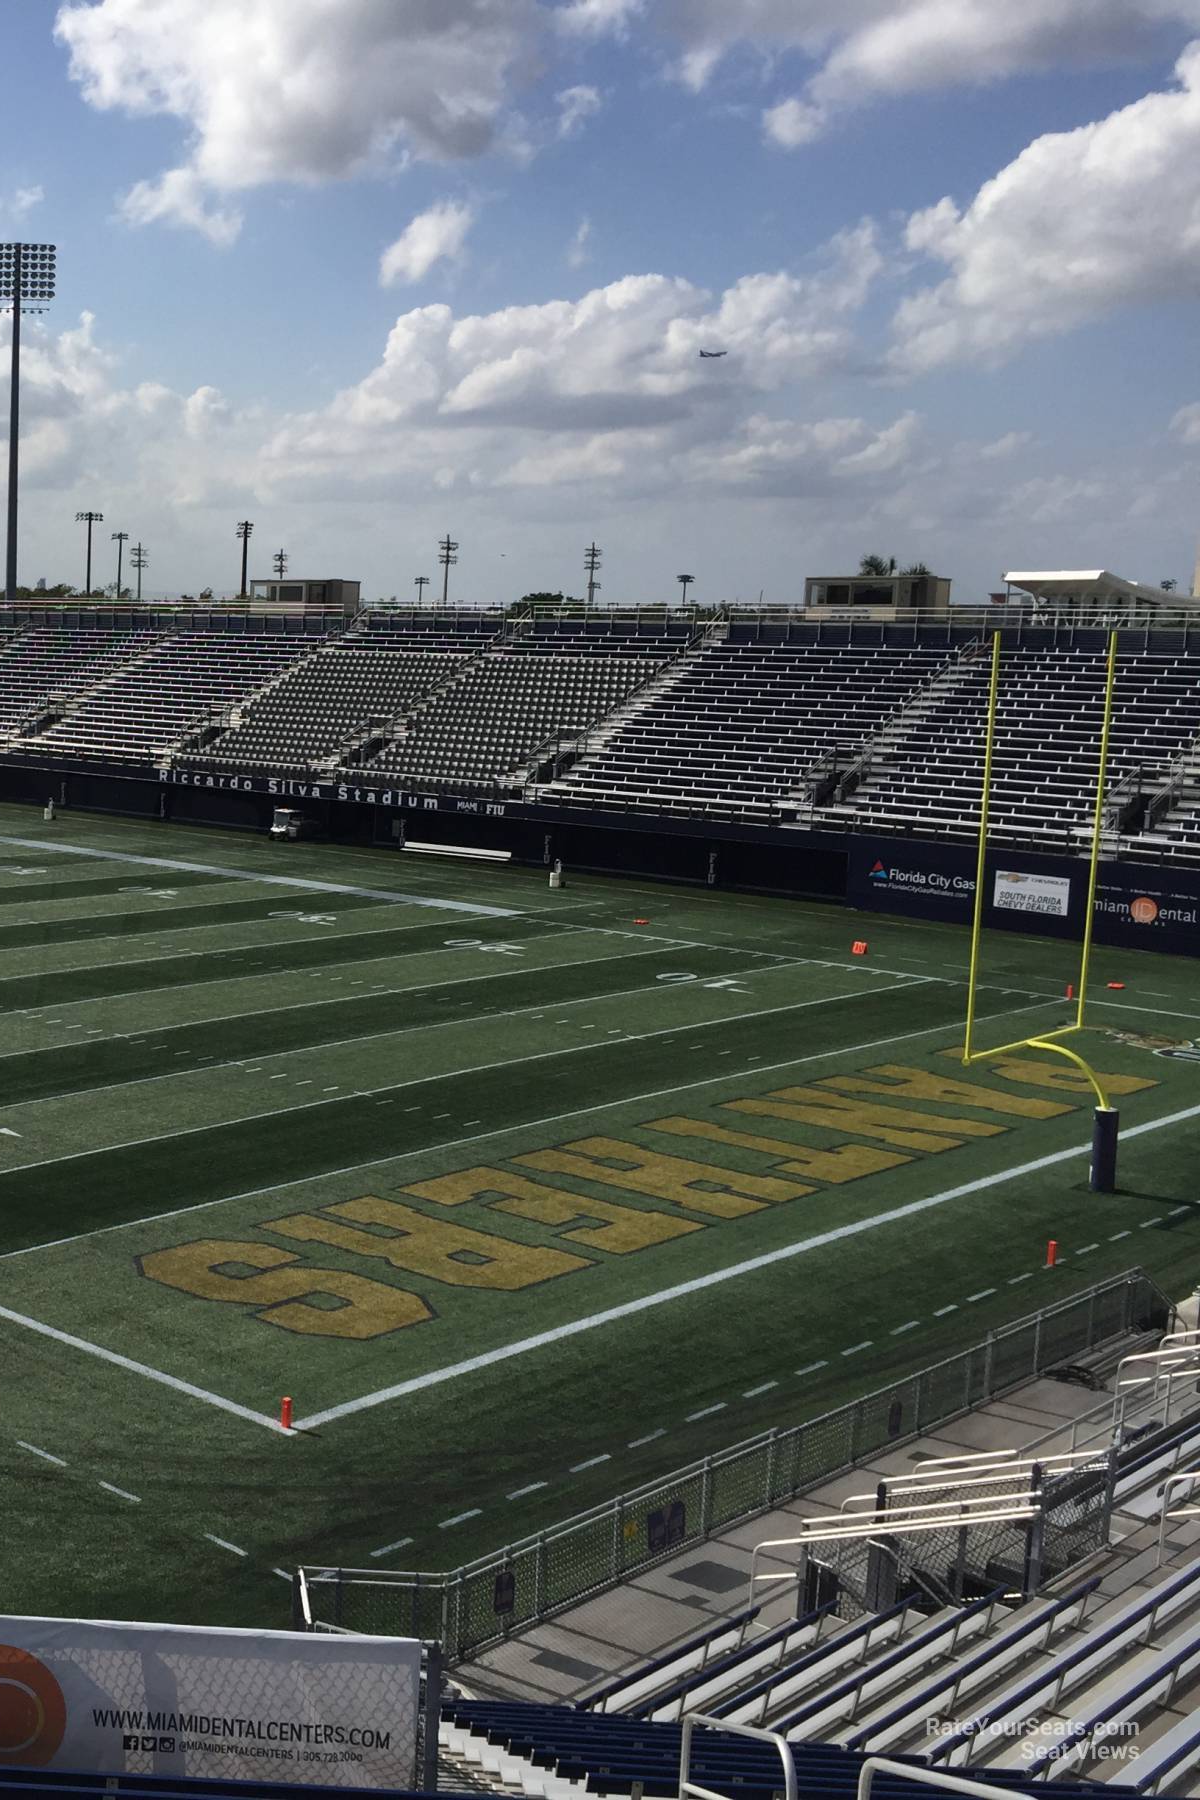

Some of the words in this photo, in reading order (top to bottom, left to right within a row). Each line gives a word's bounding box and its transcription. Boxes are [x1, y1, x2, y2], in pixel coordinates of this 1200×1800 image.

[159, 769, 253, 790] Riccardo
[268, 780, 321, 798] Silva
[338, 786, 438, 810] Stadium
[457, 801, 478, 812] MIAMI
[486, 804, 505, 816] FIU
[707, 853, 718, 884] FIU
[889, 868, 926, 884] Florida
[928, 873, 951, 889] City
[953, 876, 976, 890] Gas
[998, 899, 1024, 908] CHEVY
[1025, 902, 1062, 913] DEALERS
[1000, 891, 1026, 901] SOUTH
[1028, 894, 1062, 905] FLORIDA
[133, 1047, 1164, 1340] PANTHERS
[93, 1709, 391, 1750] WWW.MIAMIDENTALCENTERS.COM
[179, 1741, 294, 1760] @MIAMIDENTALCENTERS
